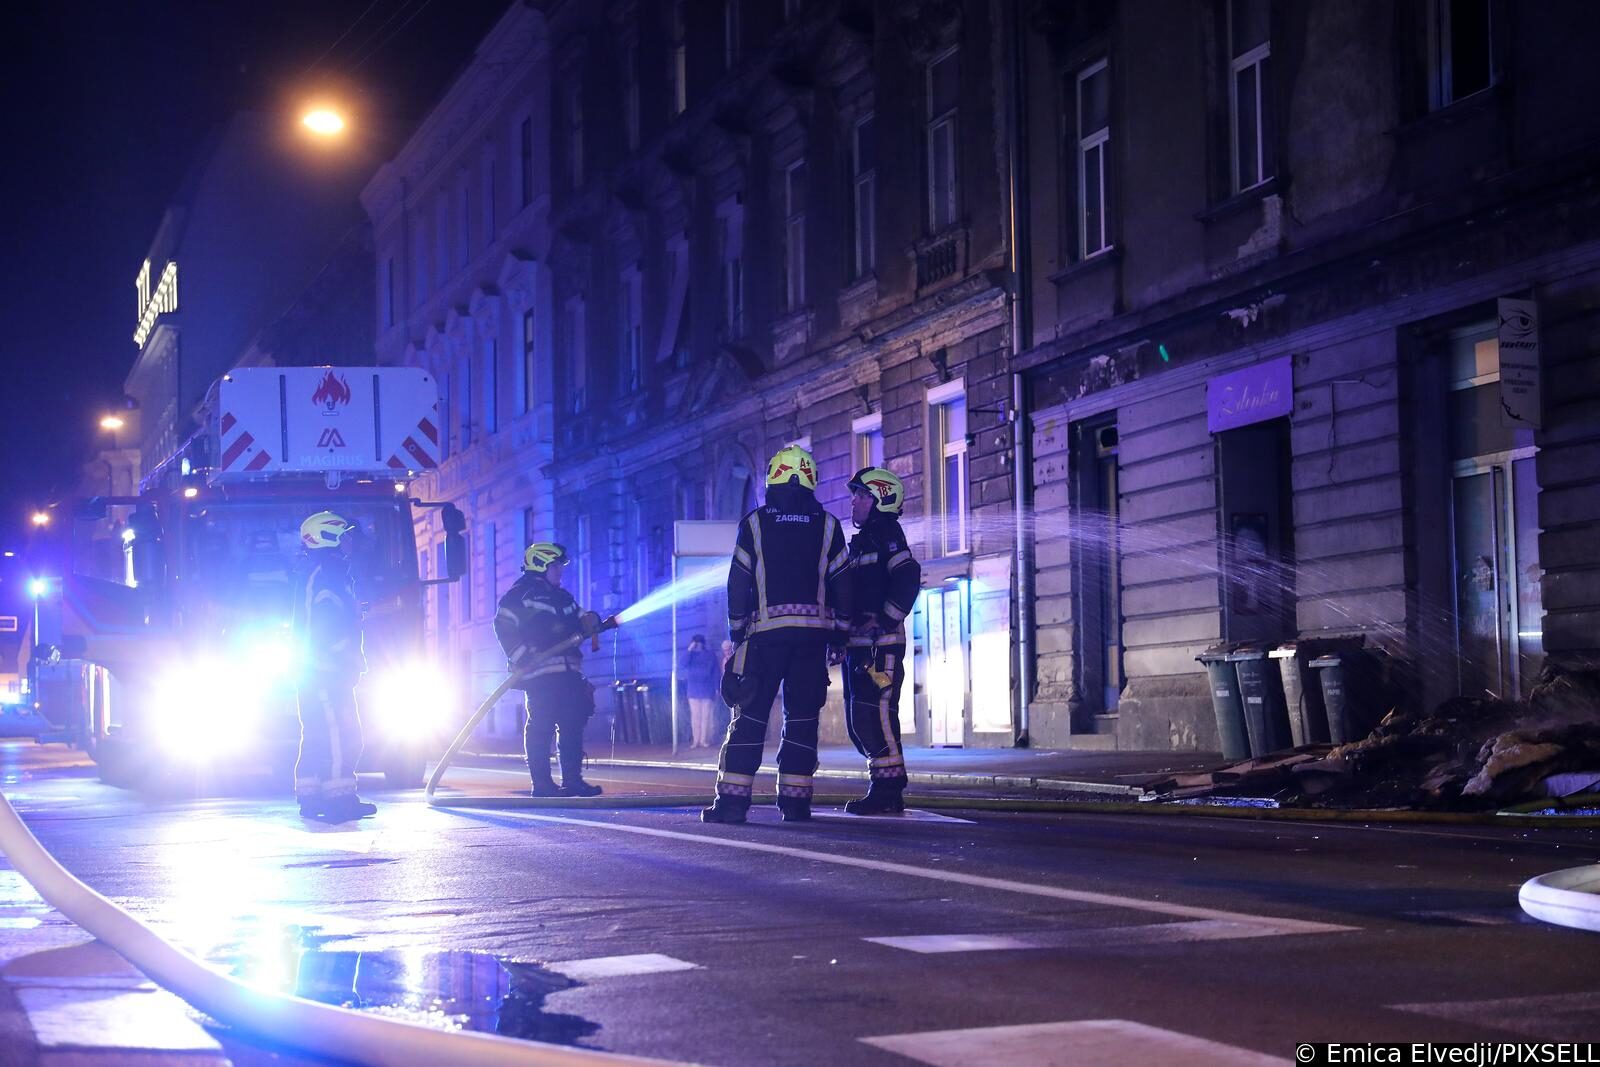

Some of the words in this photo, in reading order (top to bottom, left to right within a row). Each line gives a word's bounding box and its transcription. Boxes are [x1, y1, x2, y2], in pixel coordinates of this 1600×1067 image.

[300, 455, 363, 466] MAGIRUS
[800, 457, 811, 468] A+
[877, 486, 892, 497] 18+
[775, 514, 810, 523] ZAGREB
